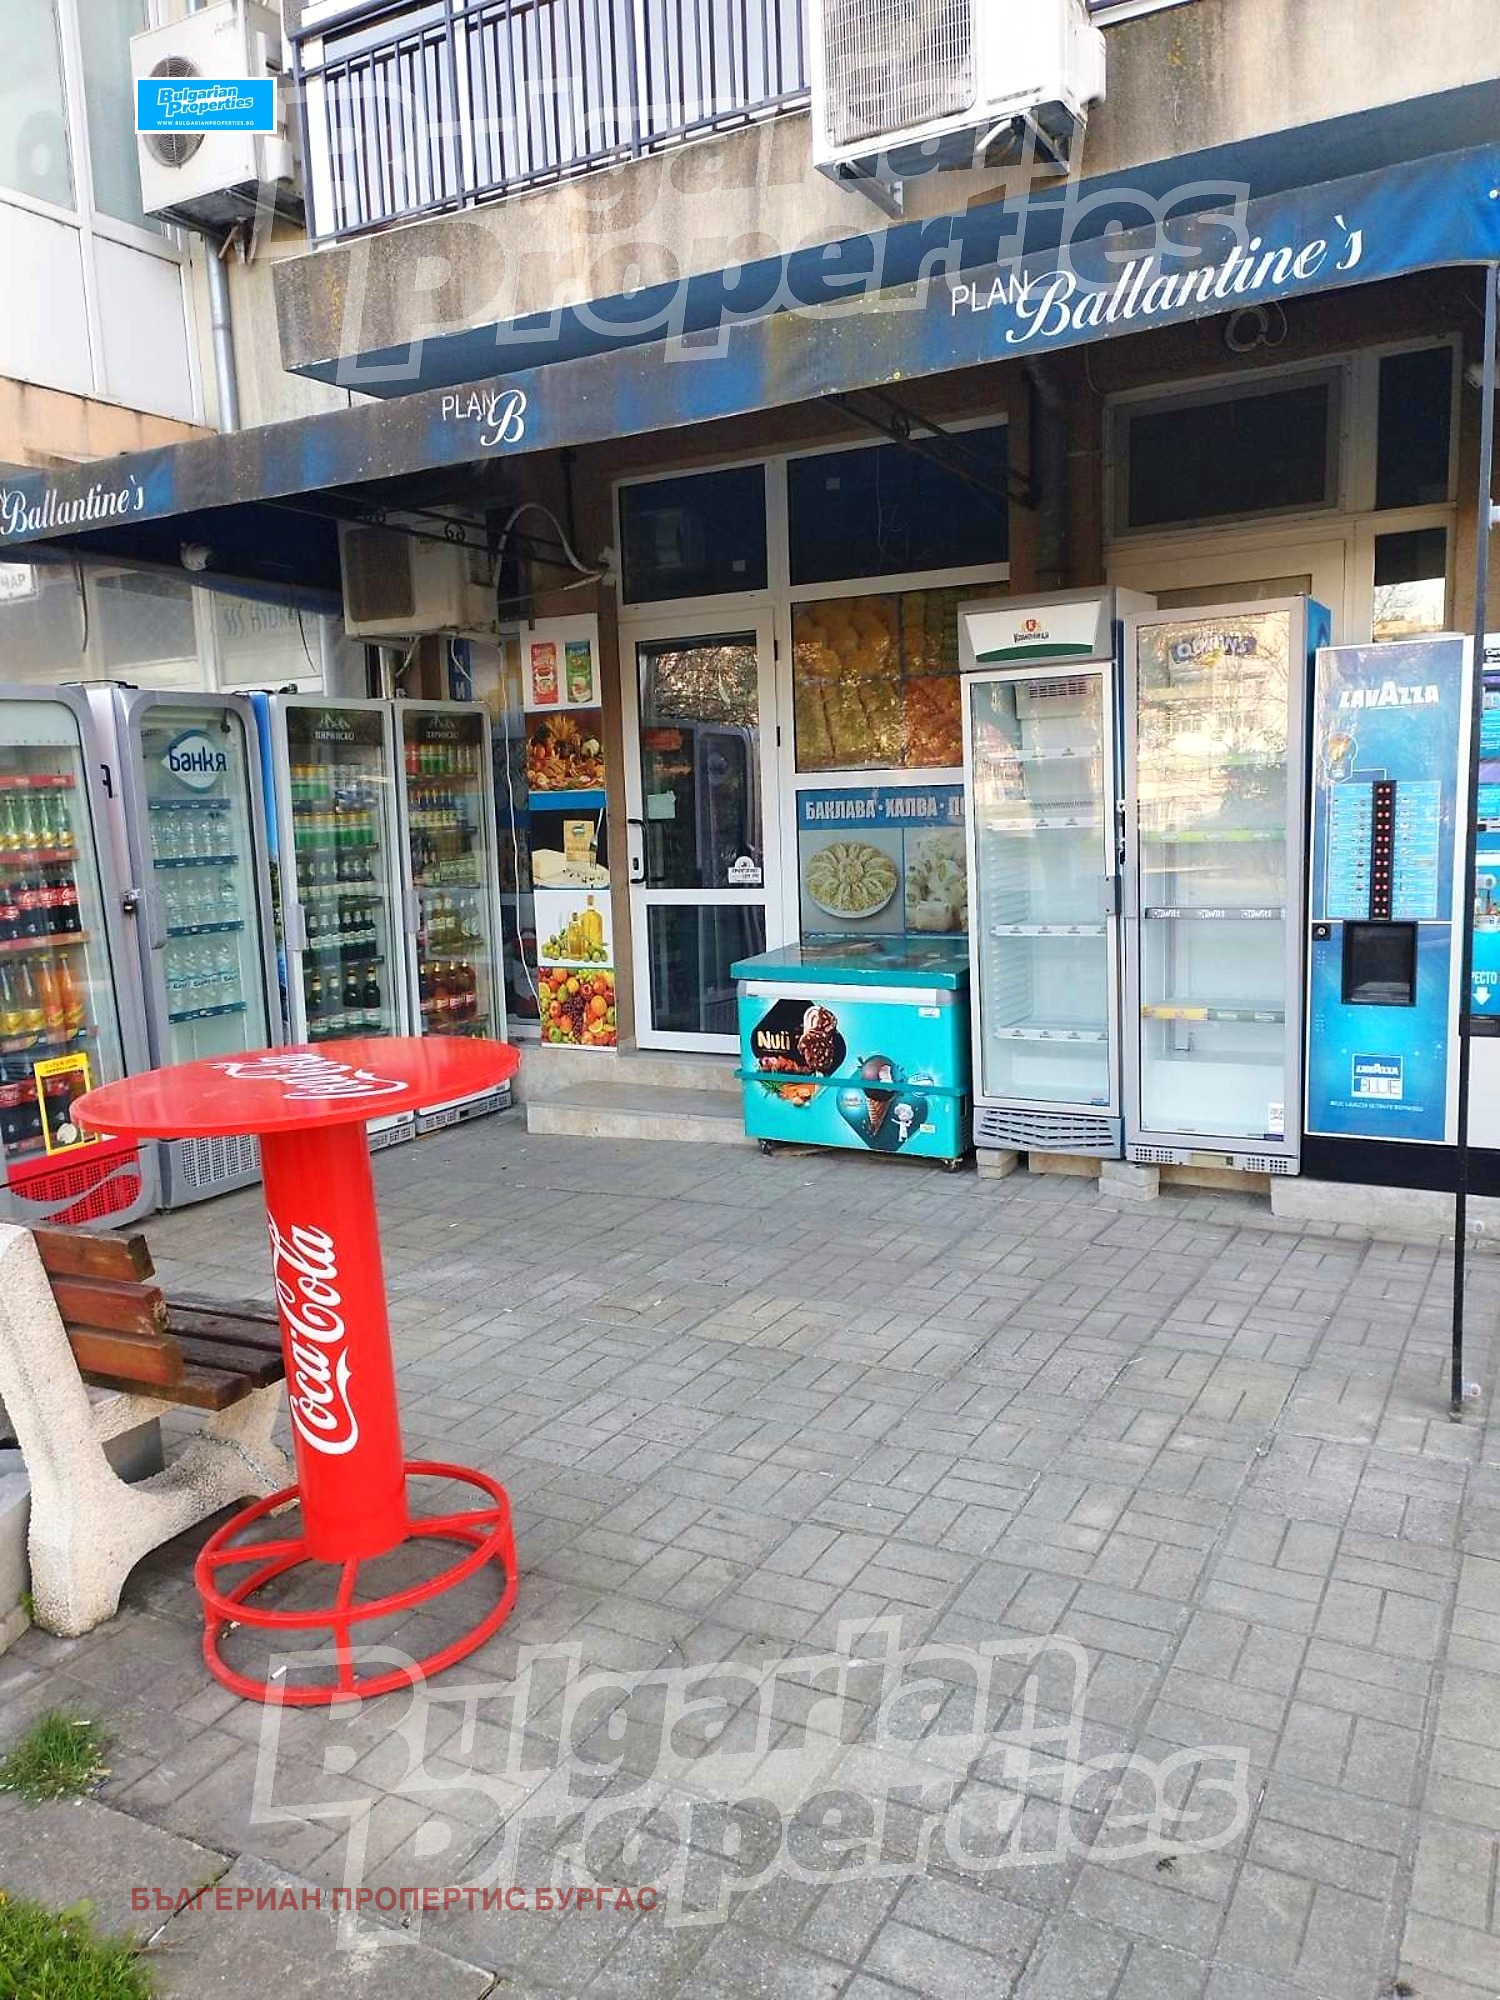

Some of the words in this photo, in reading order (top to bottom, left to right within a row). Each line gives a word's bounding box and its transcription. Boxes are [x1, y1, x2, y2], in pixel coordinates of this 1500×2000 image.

[951, 269, 1030, 316] PLAN
[442, 388, 496, 421] PLAN
[480, 389, 527, 446] B
[1339, 680, 1440, 709] LAVAZZA
[806, 799, 876, 821] БАКЛАВА
[885, 796, 938, 818] ХАЛВА
